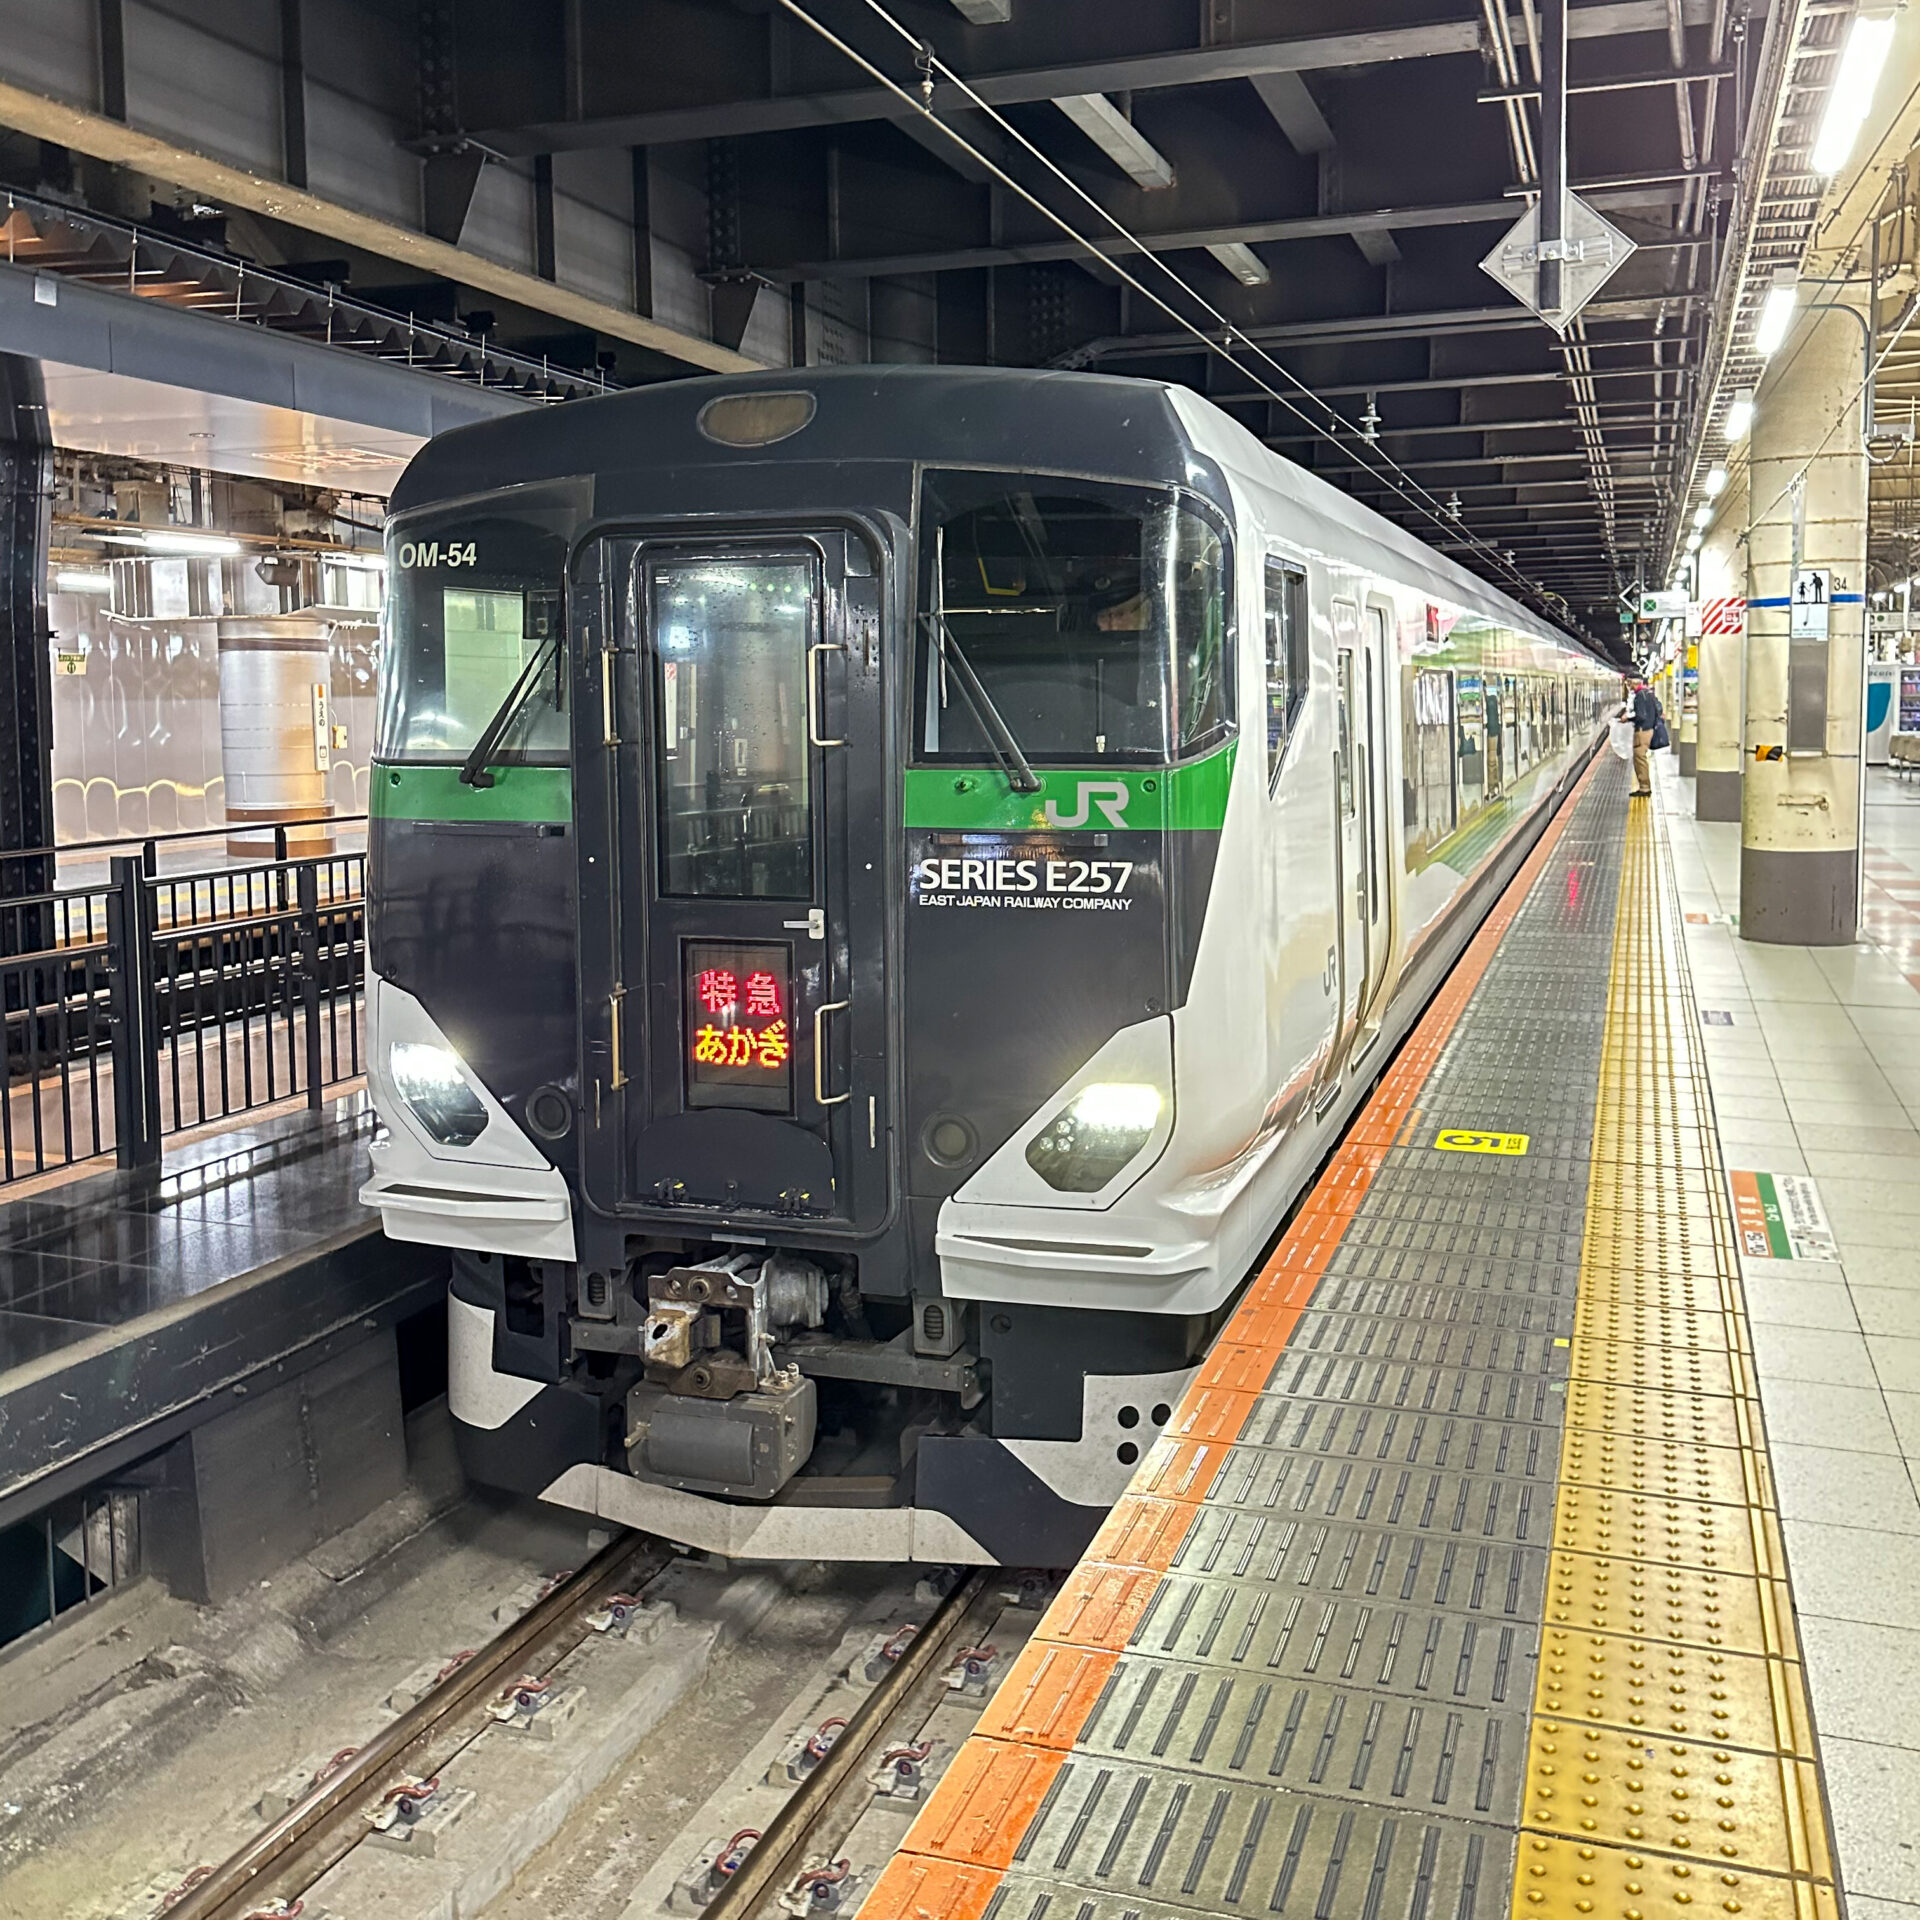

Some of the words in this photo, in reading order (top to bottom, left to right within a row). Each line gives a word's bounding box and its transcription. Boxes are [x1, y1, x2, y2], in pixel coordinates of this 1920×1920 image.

[398, 542, 478, 568] OM-54
[1833, 577, 1847, 592] 34
[318, 700, 326, 727] うえの
[1045, 781, 1130, 828] JR
[919, 858, 1037, 892] SERIES
[1046, 861, 1133, 893] E257
[919, 895, 955, 907] EAST
[956, 895, 1001, 908] JAPAN
[1004, 897, 1060, 909] RAILWAY
[1062, 898, 1133, 911] COMPANY
[1322, 945, 1336, 995] JR
[700, 969, 780, 1016] 特急
[695, 1019, 789, 1068] あかぎ
